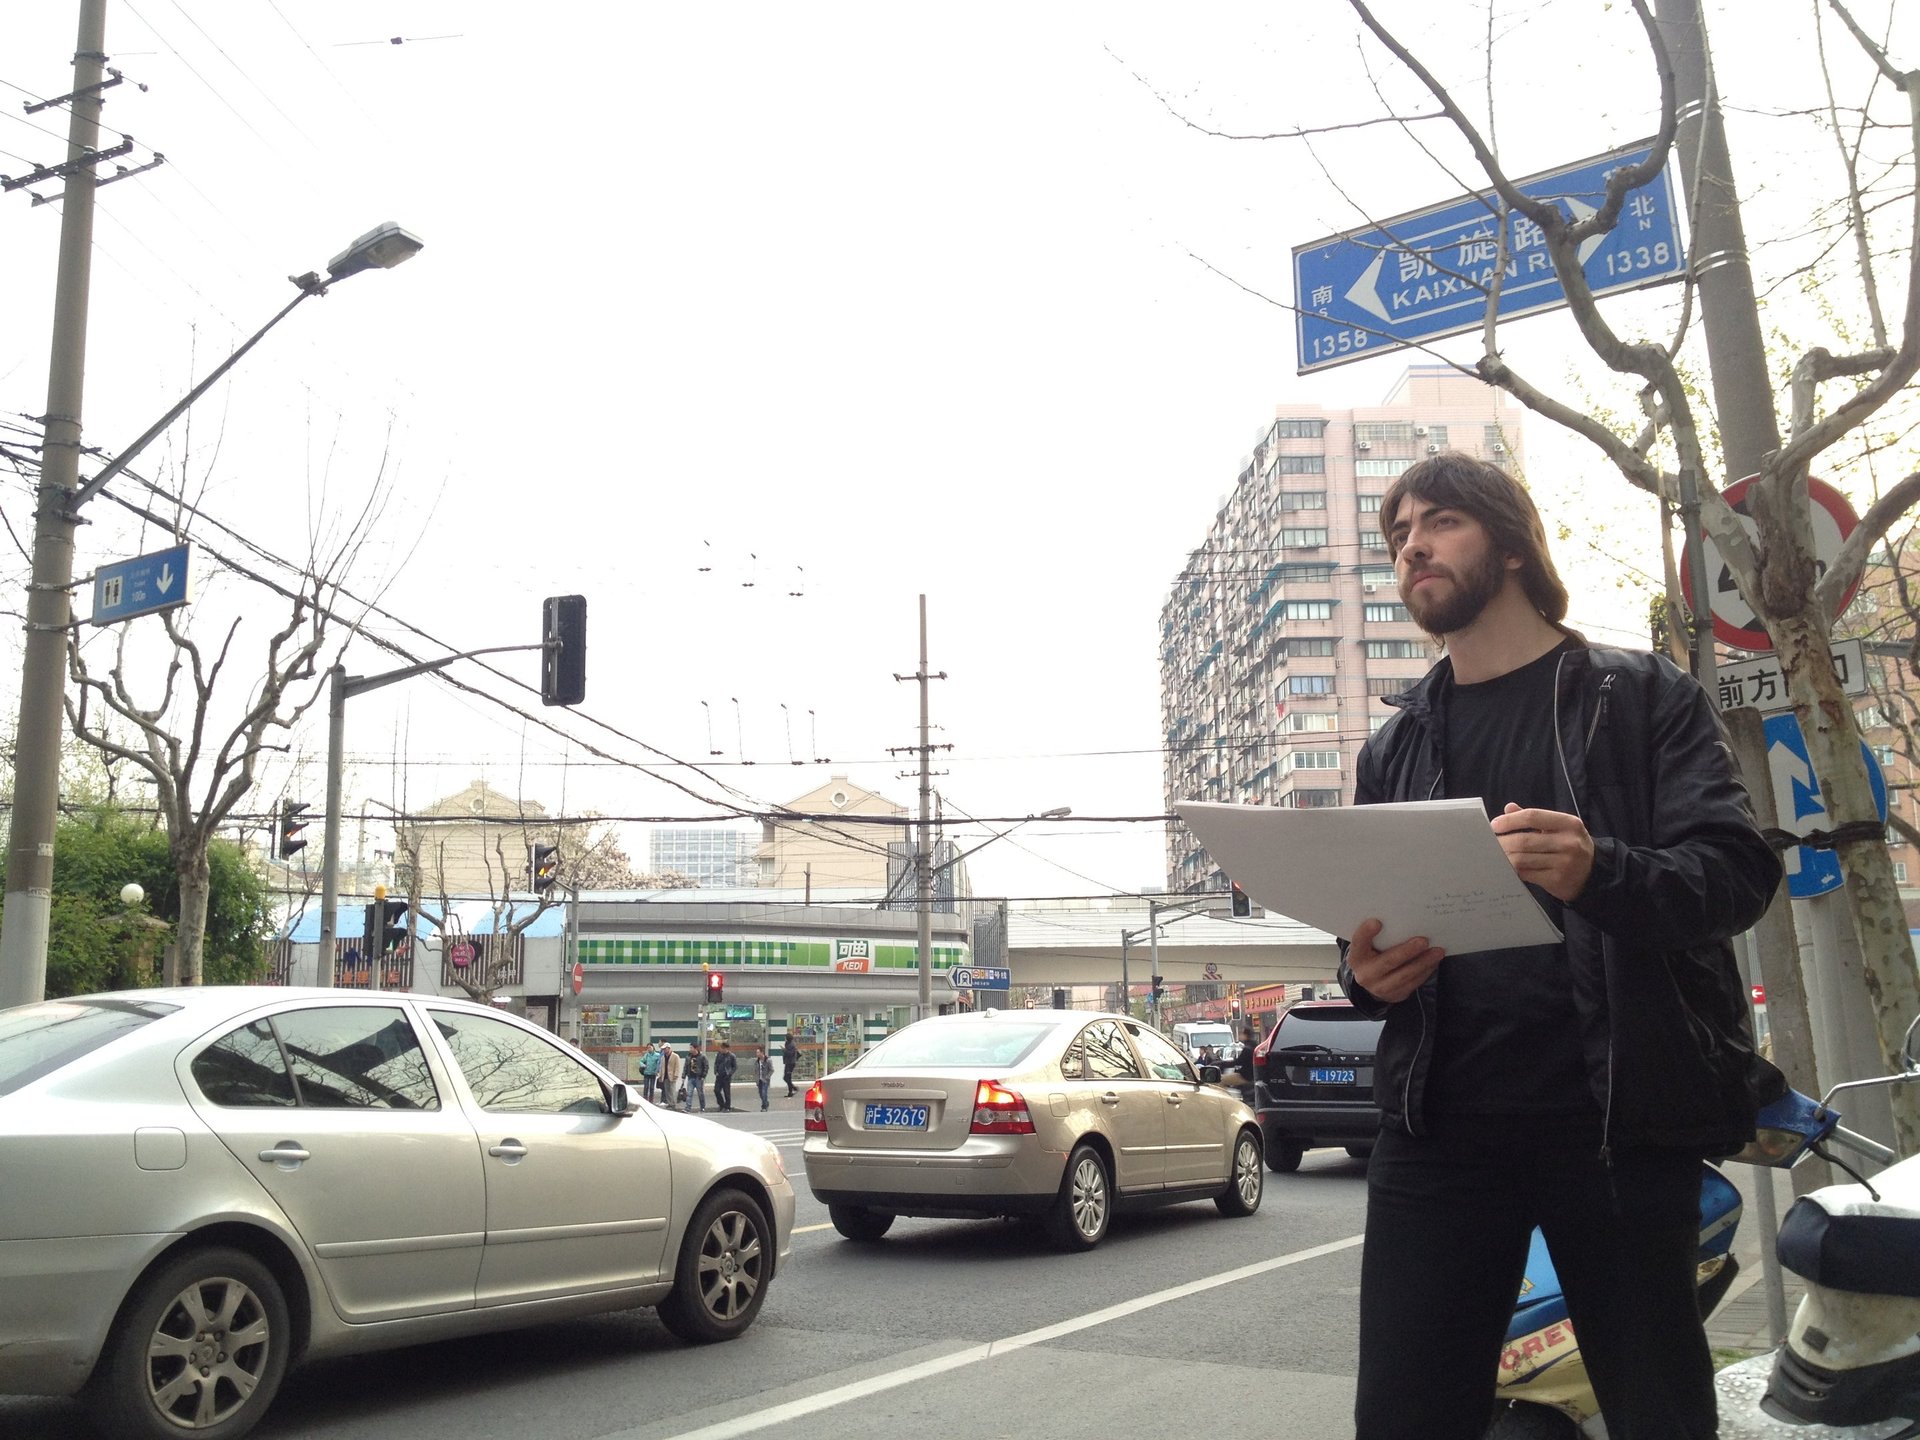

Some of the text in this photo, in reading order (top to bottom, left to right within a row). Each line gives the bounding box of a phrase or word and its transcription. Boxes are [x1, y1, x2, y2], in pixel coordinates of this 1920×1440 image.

[1628, 194, 1655, 217] 北
[1639, 217, 1652, 231] N
[1398, 214, 1547, 284] 凯旋路
[1606, 241, 1670, 276] 1338
[1392, 251, 1556, 310] KAIXUAN R
[1311, 284, 1333, 308] 南
[1318, 307, 1329, 318] S
[1313, 327, 1369, 359] 1358
[842, 961, 864, 971] KEDI
